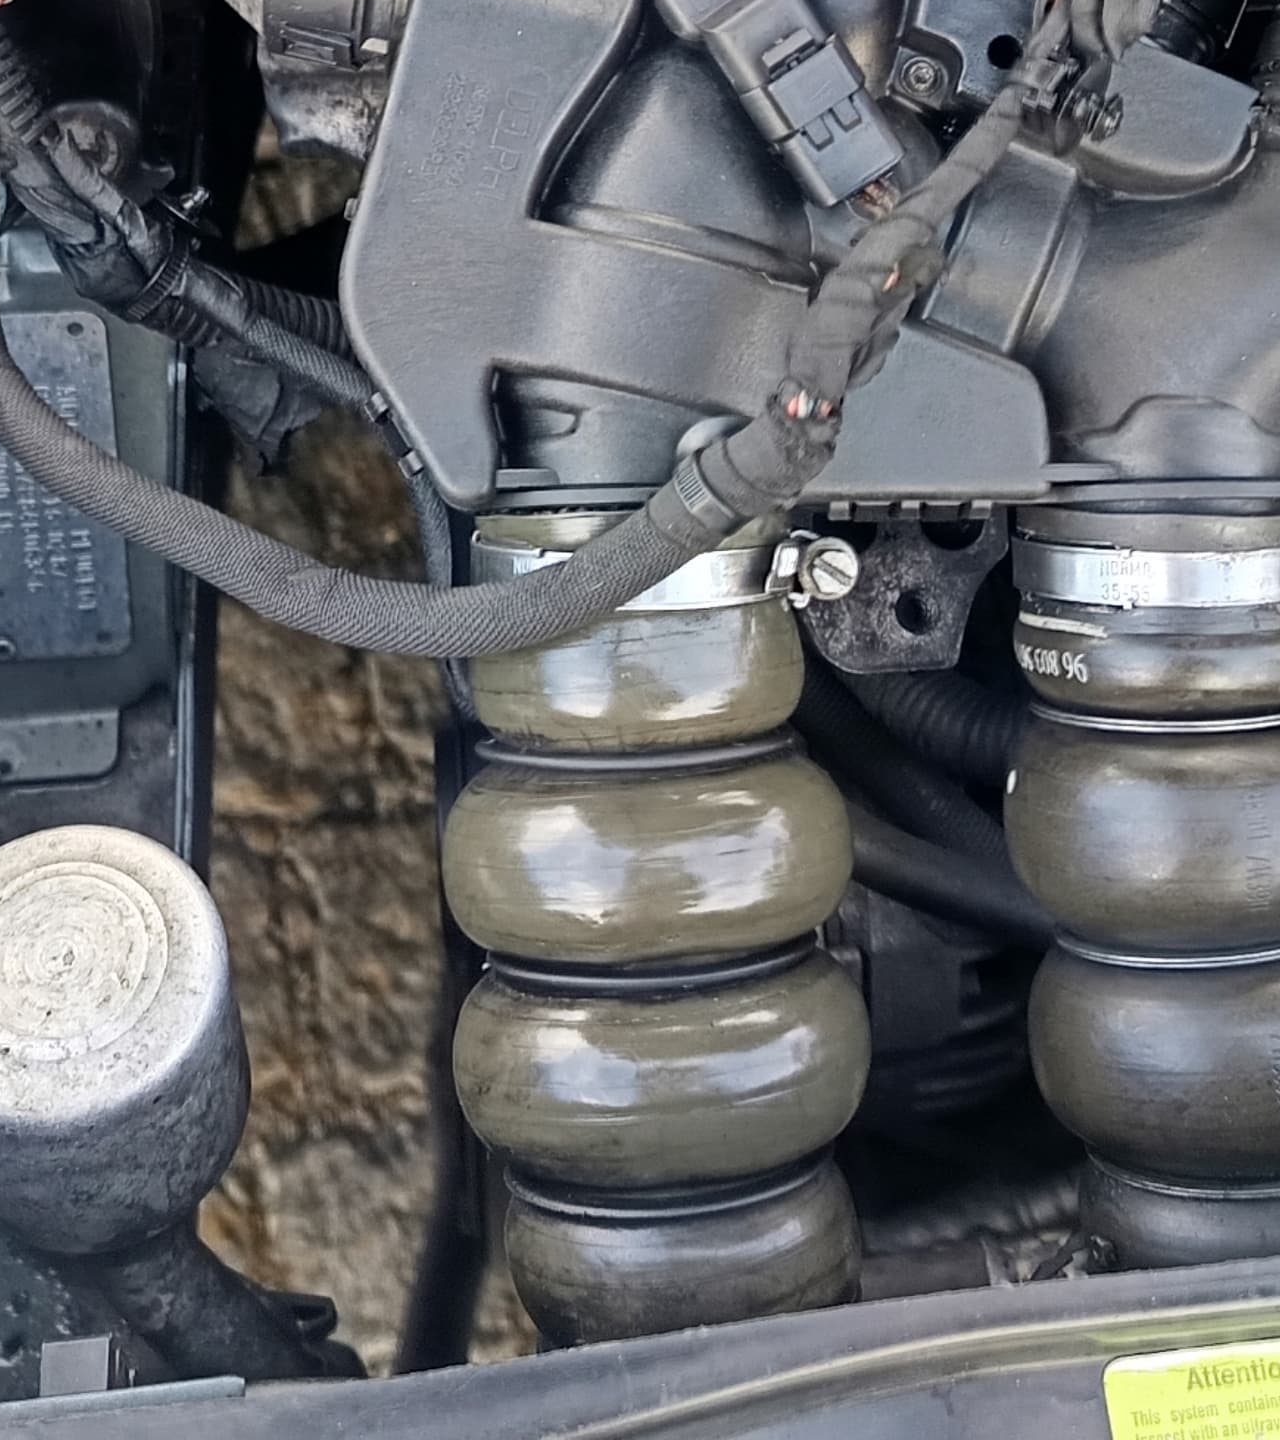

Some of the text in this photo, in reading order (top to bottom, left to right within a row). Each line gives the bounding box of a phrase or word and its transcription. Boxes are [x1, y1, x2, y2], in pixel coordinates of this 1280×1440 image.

[1130, 1409, 1161, 1427] This
[1170, 1404, 1219, 1424] system
[1222, 1423, 1239, 1437] an
